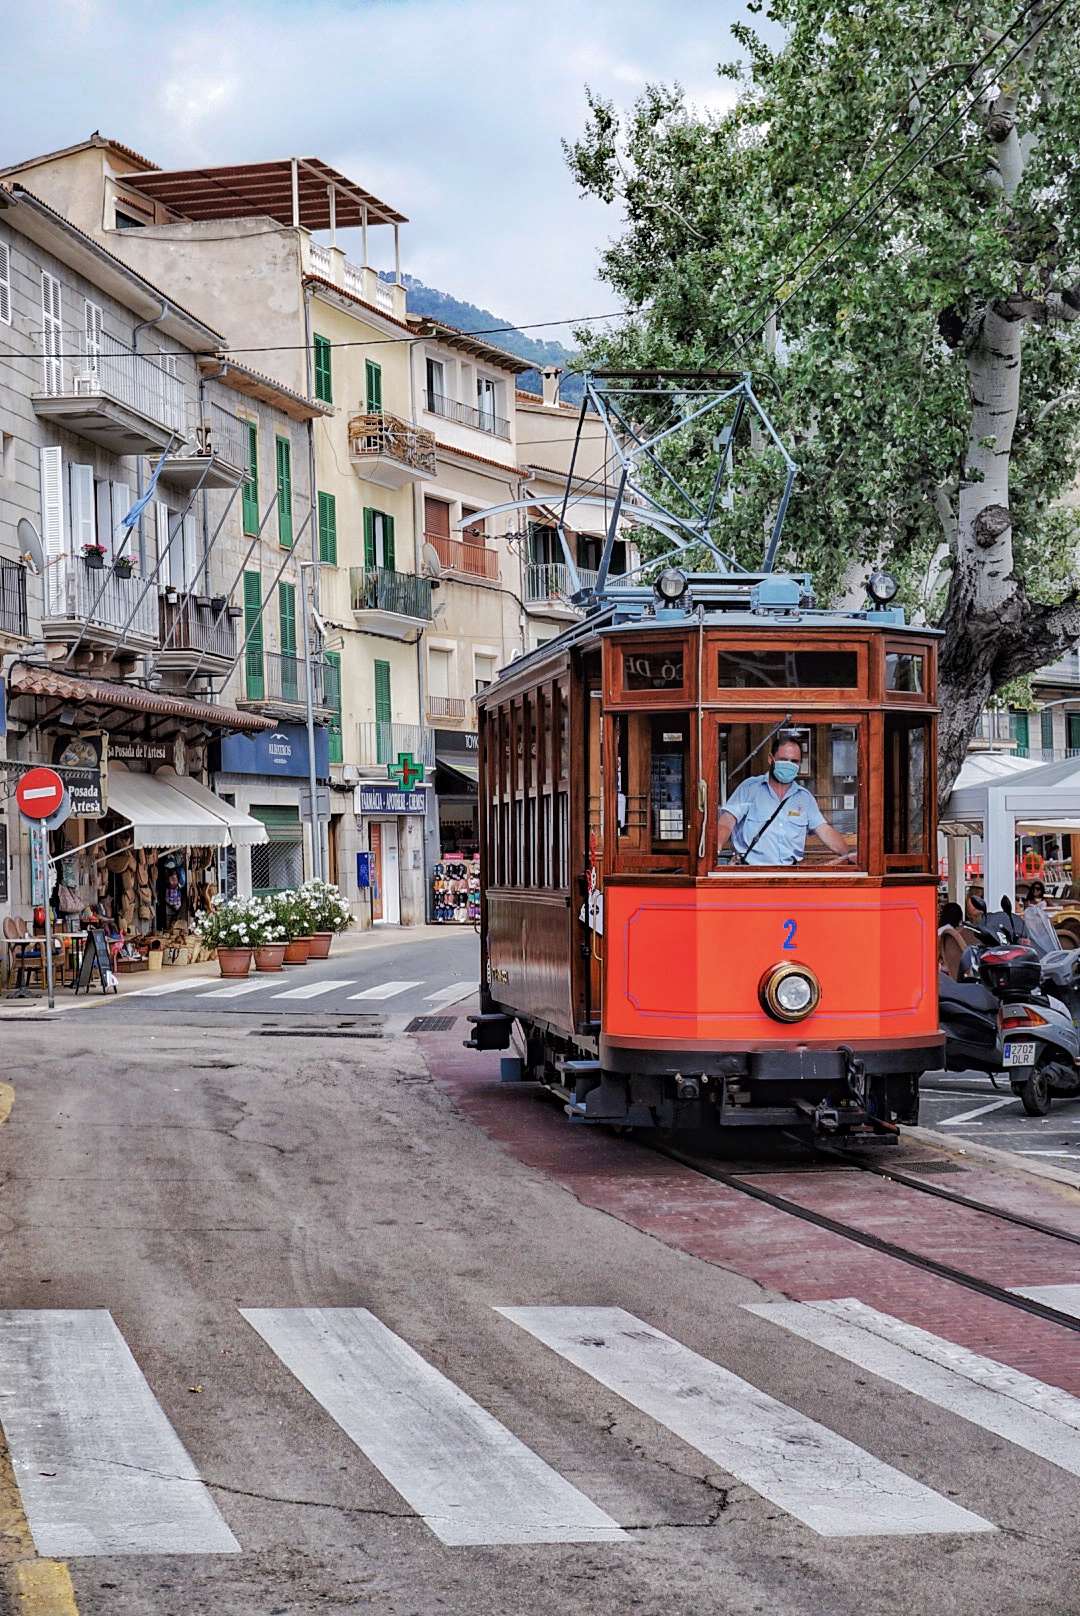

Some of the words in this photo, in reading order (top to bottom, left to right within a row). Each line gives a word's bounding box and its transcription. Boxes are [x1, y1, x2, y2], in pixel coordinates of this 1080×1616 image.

[115, 744, 135, 758] Posada
[135, 744, 143, 758] de
[68, 784, 98, 798] Posada
[361, 788, 383, 810] FARMÀCIA
[782, 919, 797, 950] 2
[1011, 1045, 1034, 1055] 2702
[1012, 1055, 1030, 1064] DLR
